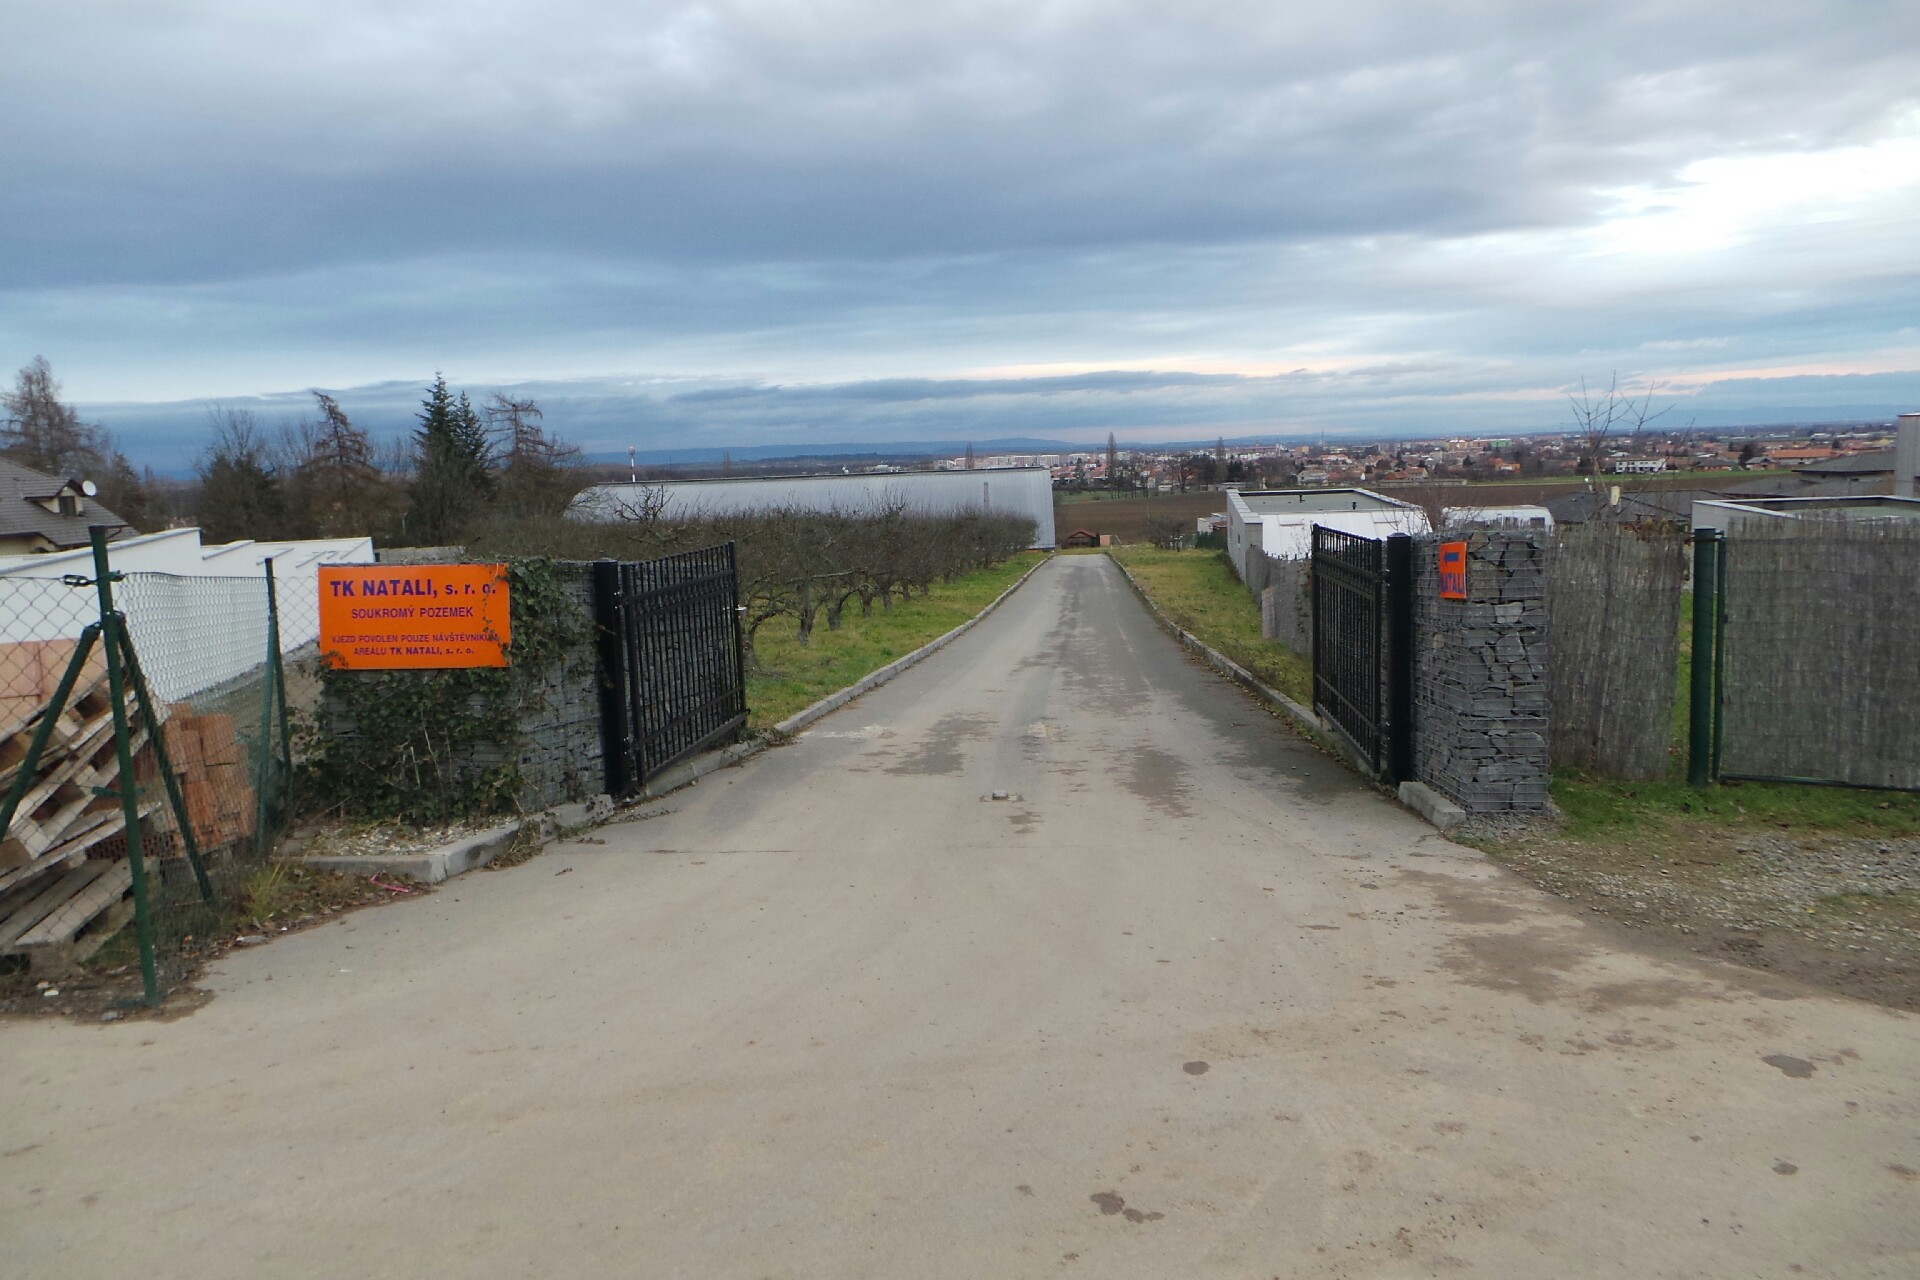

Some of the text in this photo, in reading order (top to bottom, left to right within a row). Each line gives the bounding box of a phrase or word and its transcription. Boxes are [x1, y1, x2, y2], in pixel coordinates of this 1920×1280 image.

[330, 579, 496, 598] TK NATALI, s. r. o.
[351, 605, 474, 619] SOUKROMÝ POZEMEK
[359, 634, 398, 643] POVOLEN
[401, 634, 429, 643] POUZE
[389, 646, 402, 655] TK
